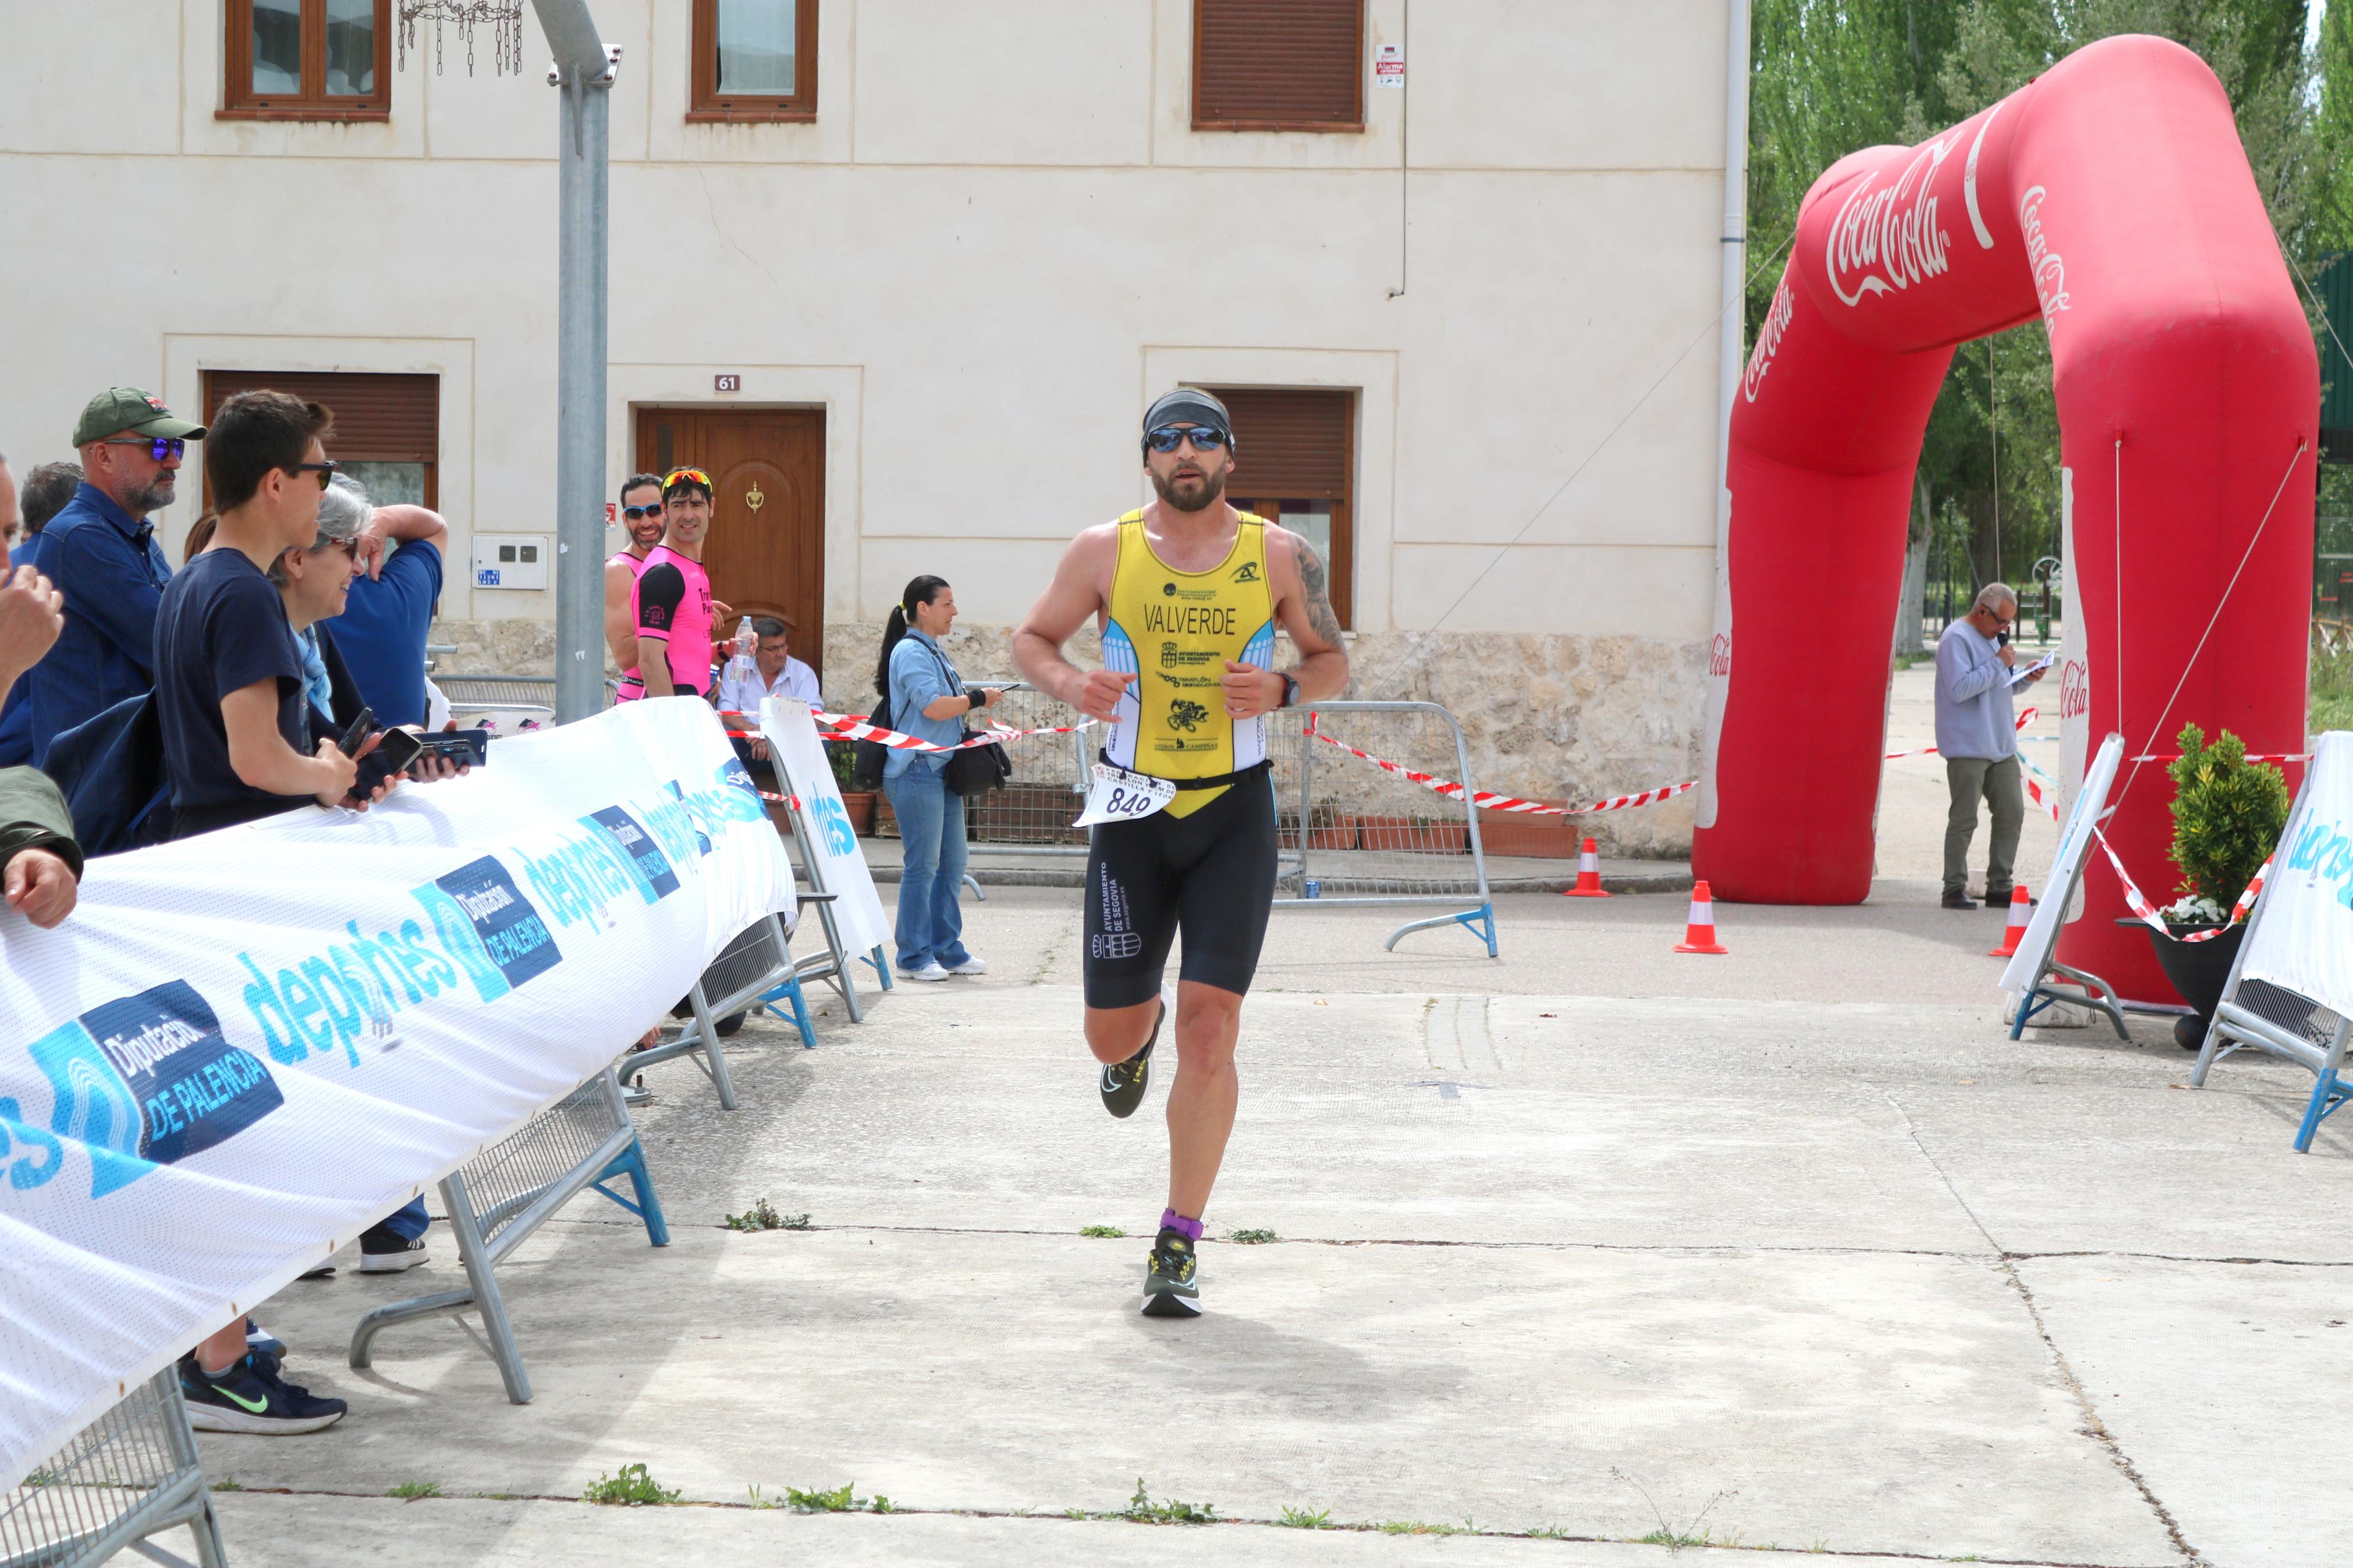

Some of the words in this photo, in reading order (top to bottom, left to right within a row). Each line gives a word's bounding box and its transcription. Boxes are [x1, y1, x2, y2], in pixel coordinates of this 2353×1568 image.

[719, 377, 734, 390] 61
[1144, 604, 1236, 635] VALVERDE
[1106, 788, 1151, 816] 849
[1108, 777, 1144, 791] CASTILLA
[1101, 862, 1112, 931] AYUNTAMIENTO
[1109, 879, 1121, 918] SEGOVIA
[1120, 886, 1130, 930] www.segovia.es
[485, 935, 510, 967] DE
[499, 915, 551, 961] PALENCIA
[1114, 919, 1123, 931] DE
[104, 1014, 205, 1078] Diputación
[145, 1091, 184, 1142] DE
[176, 1049, 267, 1123] PALENCIA
